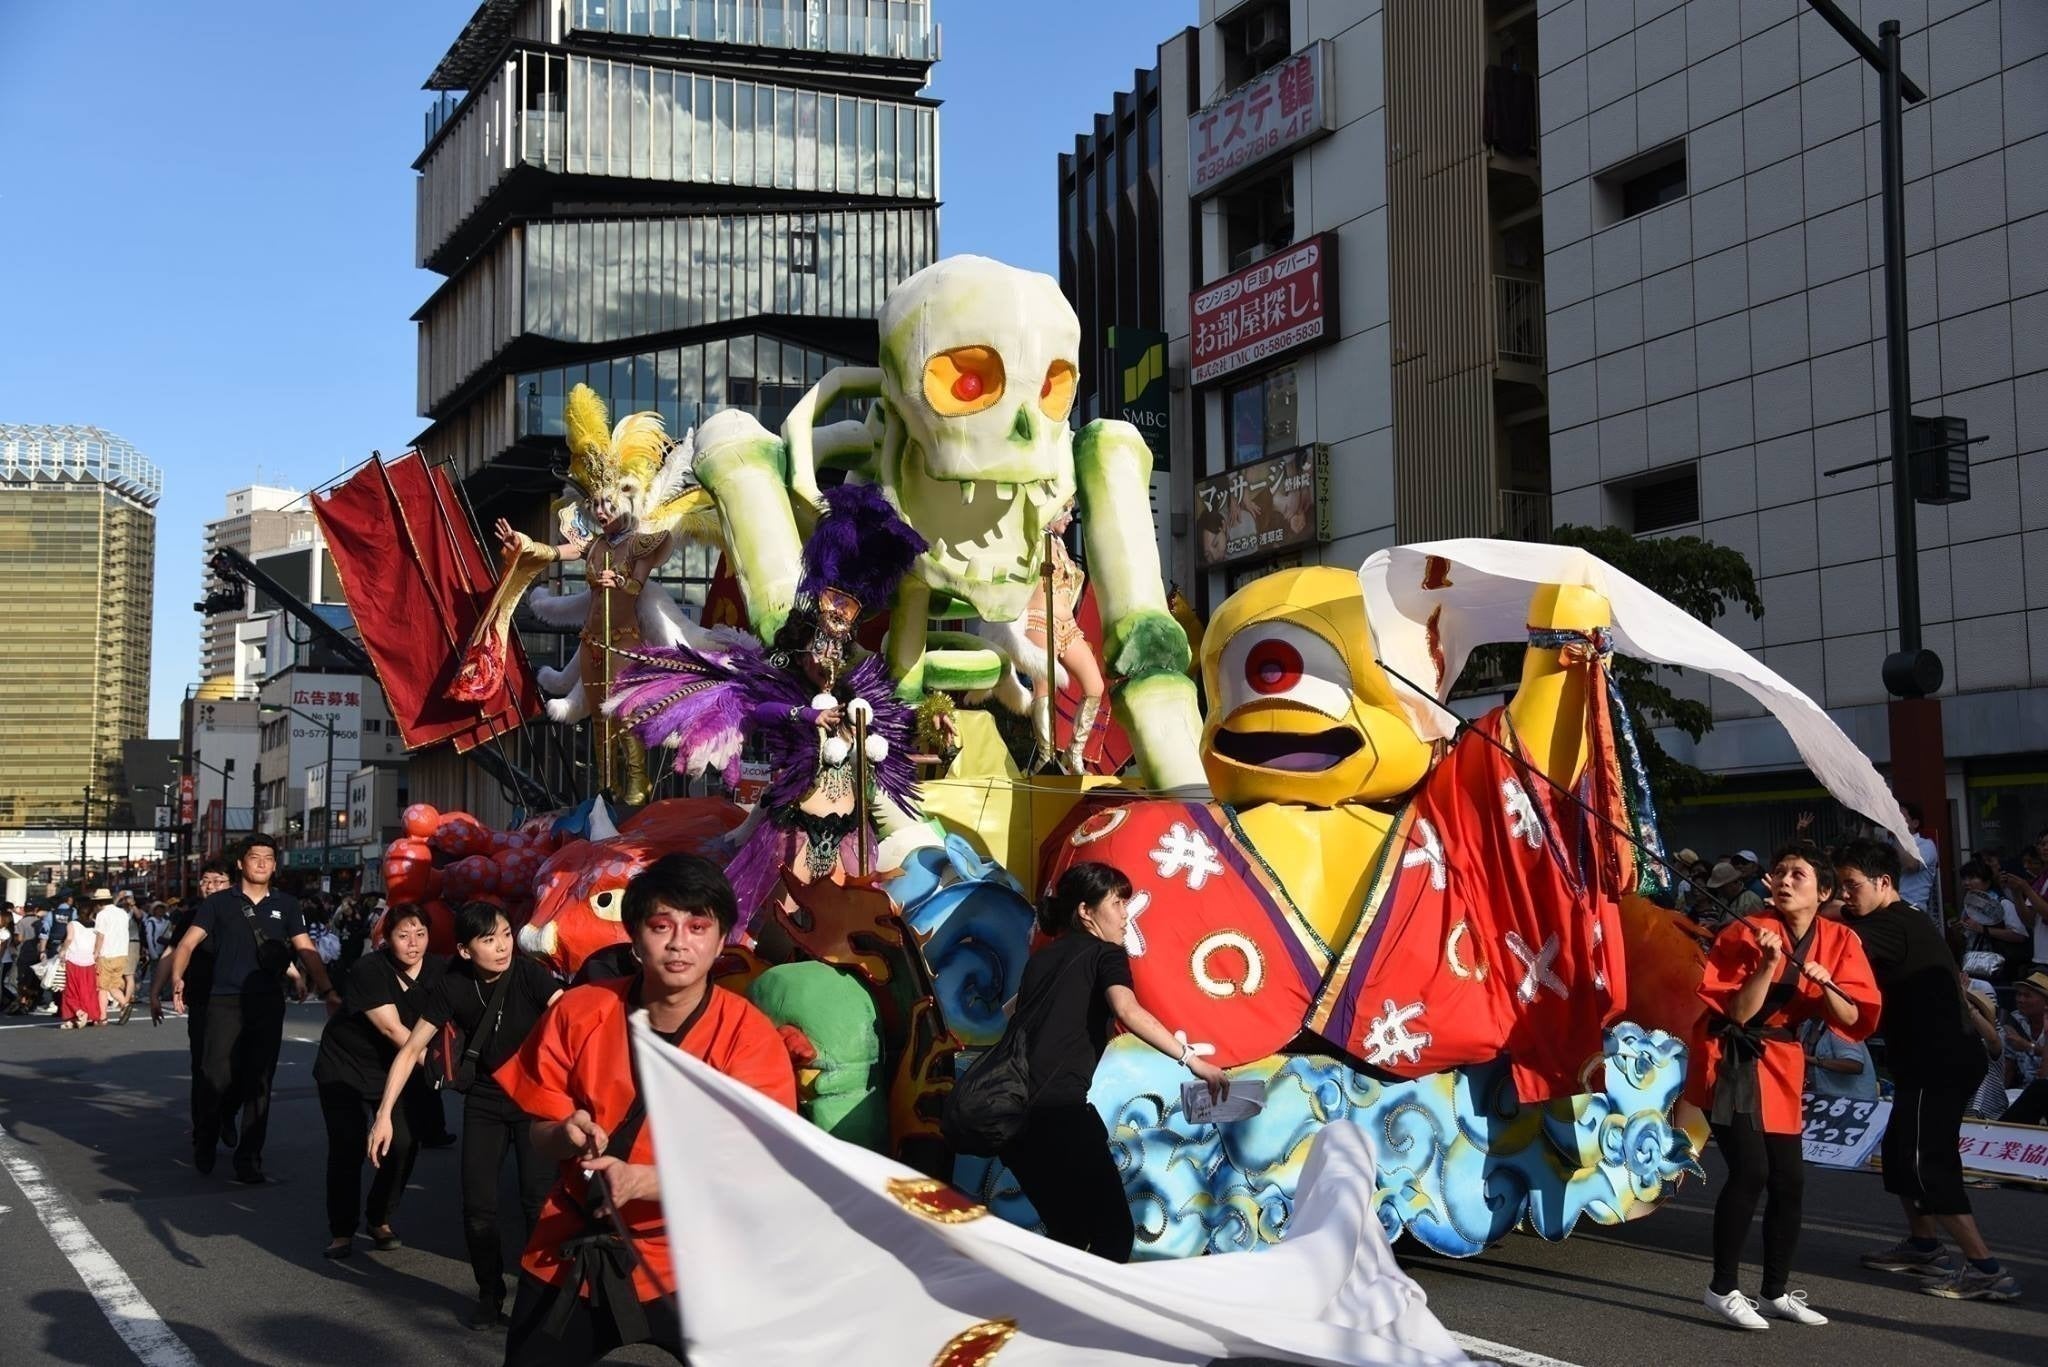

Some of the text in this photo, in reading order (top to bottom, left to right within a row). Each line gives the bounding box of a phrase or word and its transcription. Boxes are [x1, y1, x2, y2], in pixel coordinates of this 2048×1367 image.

[1197, 282, 1241, 312] マンション
[1276, 247, 1316, 277] アパート
[1253, 320, 1321, 359] 03-5806-5830
[1122, 407, 1168, 428] SMBC
[1199, 460, 1286, 513] マッサージ
[293, 689, 361, 708] 広告募集
[1801, 1119, 1864, 1146] どって
[1958, 1136, 2048, 1168] 形工業協
